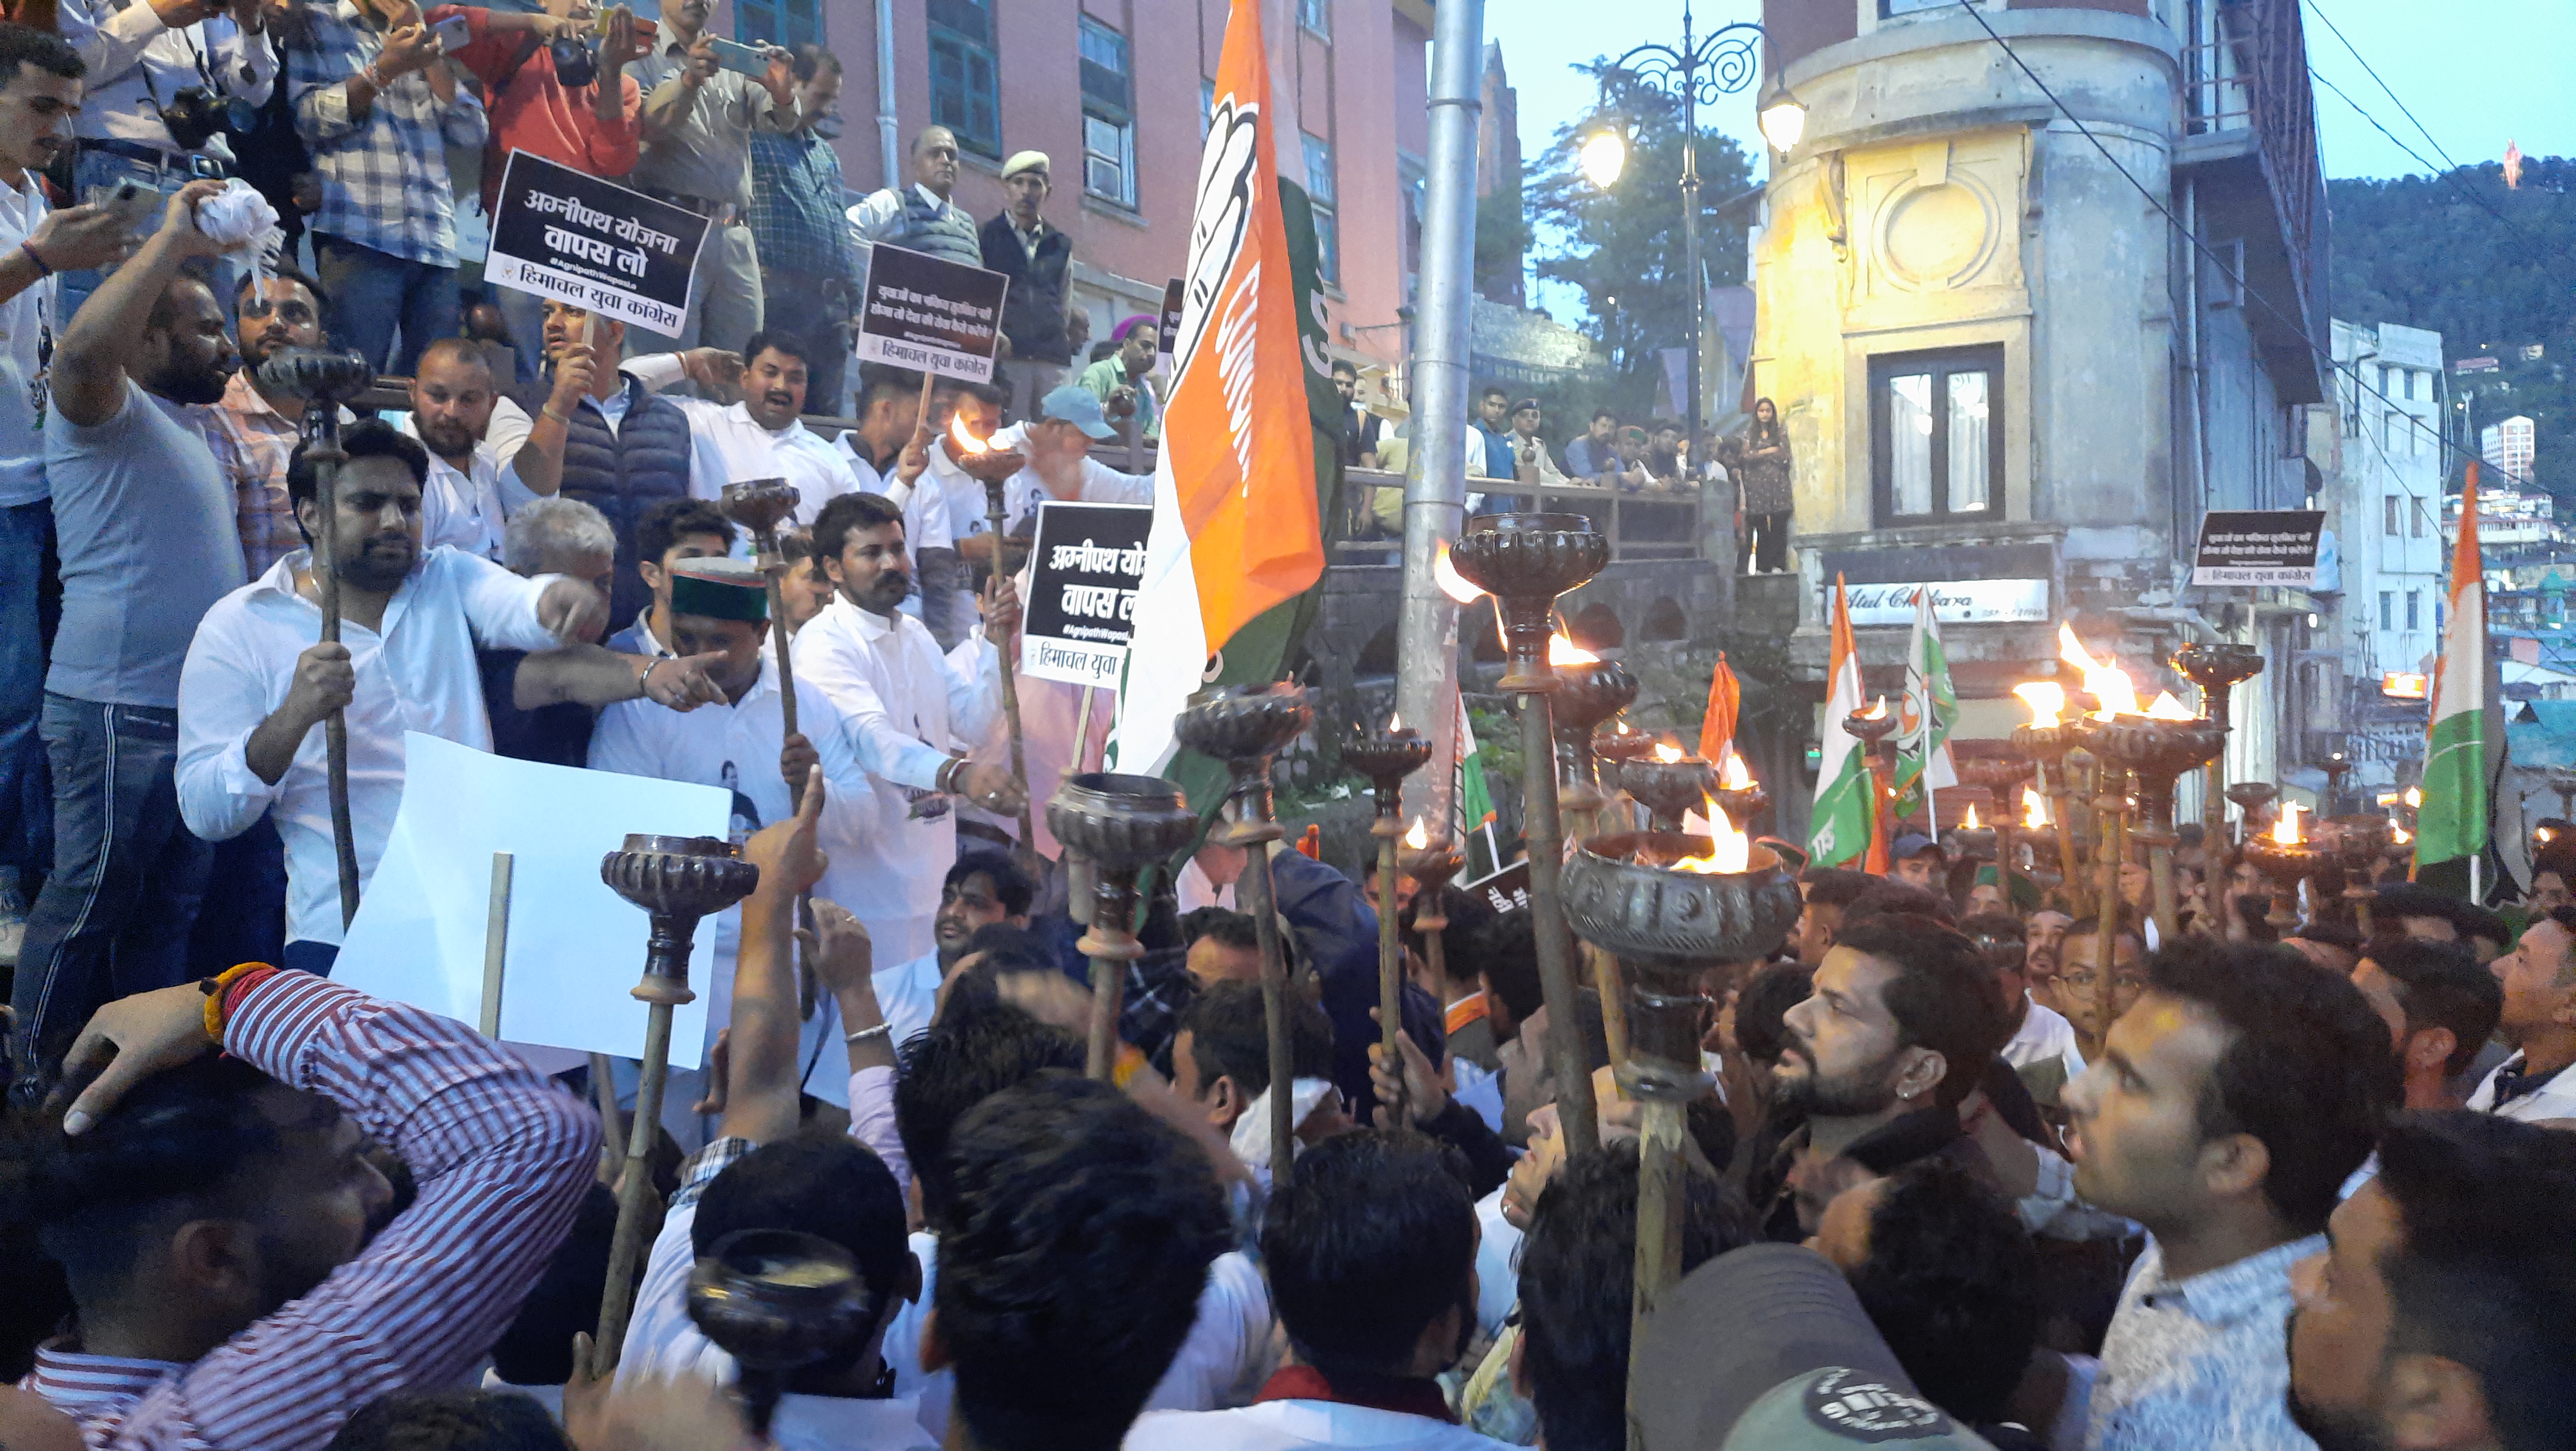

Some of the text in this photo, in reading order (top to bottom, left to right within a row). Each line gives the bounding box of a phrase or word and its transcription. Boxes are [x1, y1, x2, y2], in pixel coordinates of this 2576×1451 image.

[524, 189, 680, 255] अग्नीपथ योजना
[544, 224, 648, 277] वापस लो
[519, 263, 679, 328] हिमाचल युवा कांग्रेस
[882, 339, 928, 364] हिमाचल
[930, 353, 951, 370] युवा
[1048, 538, 1120, 574] अग्नीपथ
[1061, 584, 1119, 619] वापस
[1039, 641, 1118, 679] हिमाचल युवा
